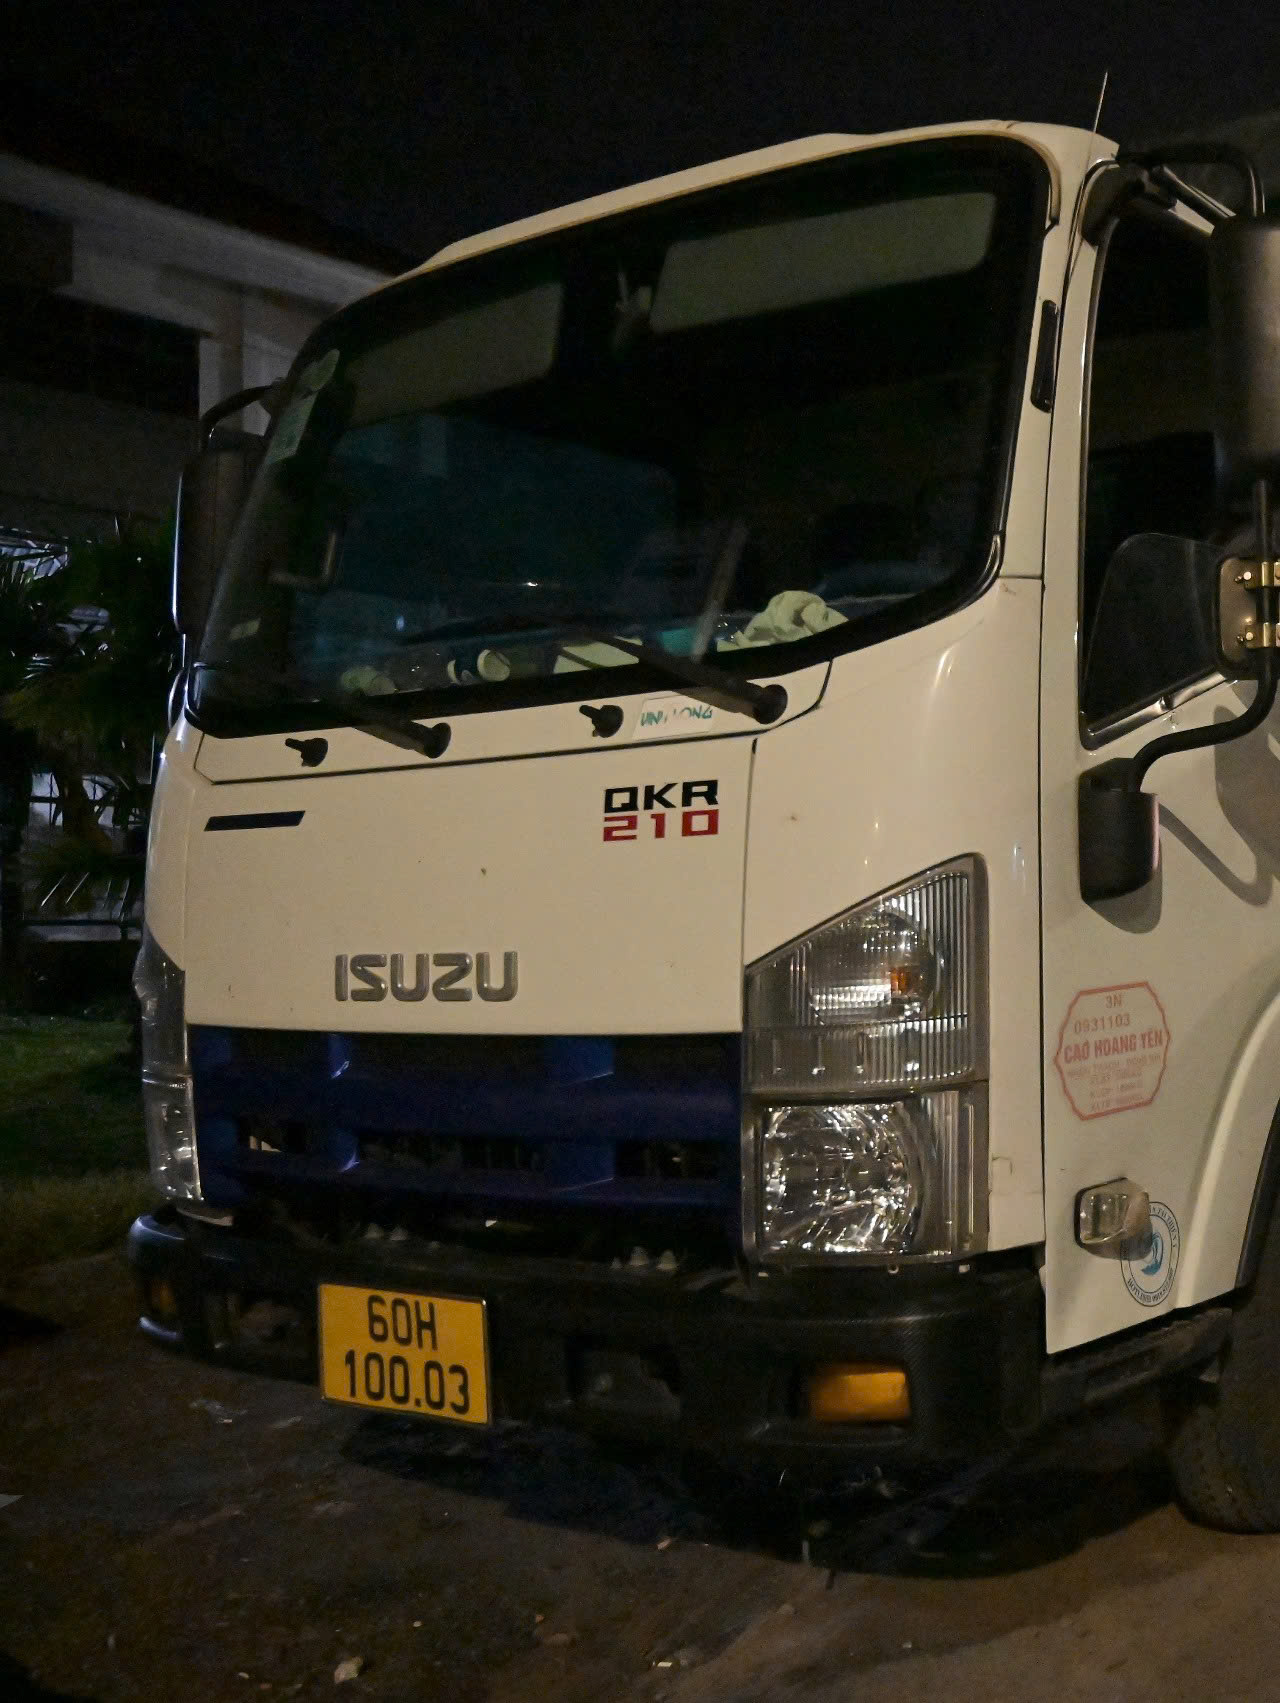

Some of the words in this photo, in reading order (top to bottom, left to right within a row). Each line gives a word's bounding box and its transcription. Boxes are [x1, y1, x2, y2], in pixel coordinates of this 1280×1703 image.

[604, 779, 719, 814] QKR
[603, 809, 719, 842] 210
[334, 951, 518, 1002] ISUZU
[367, 1294, 438, 1351] 60H
[345, 1349, 470, 1415] 100.03
